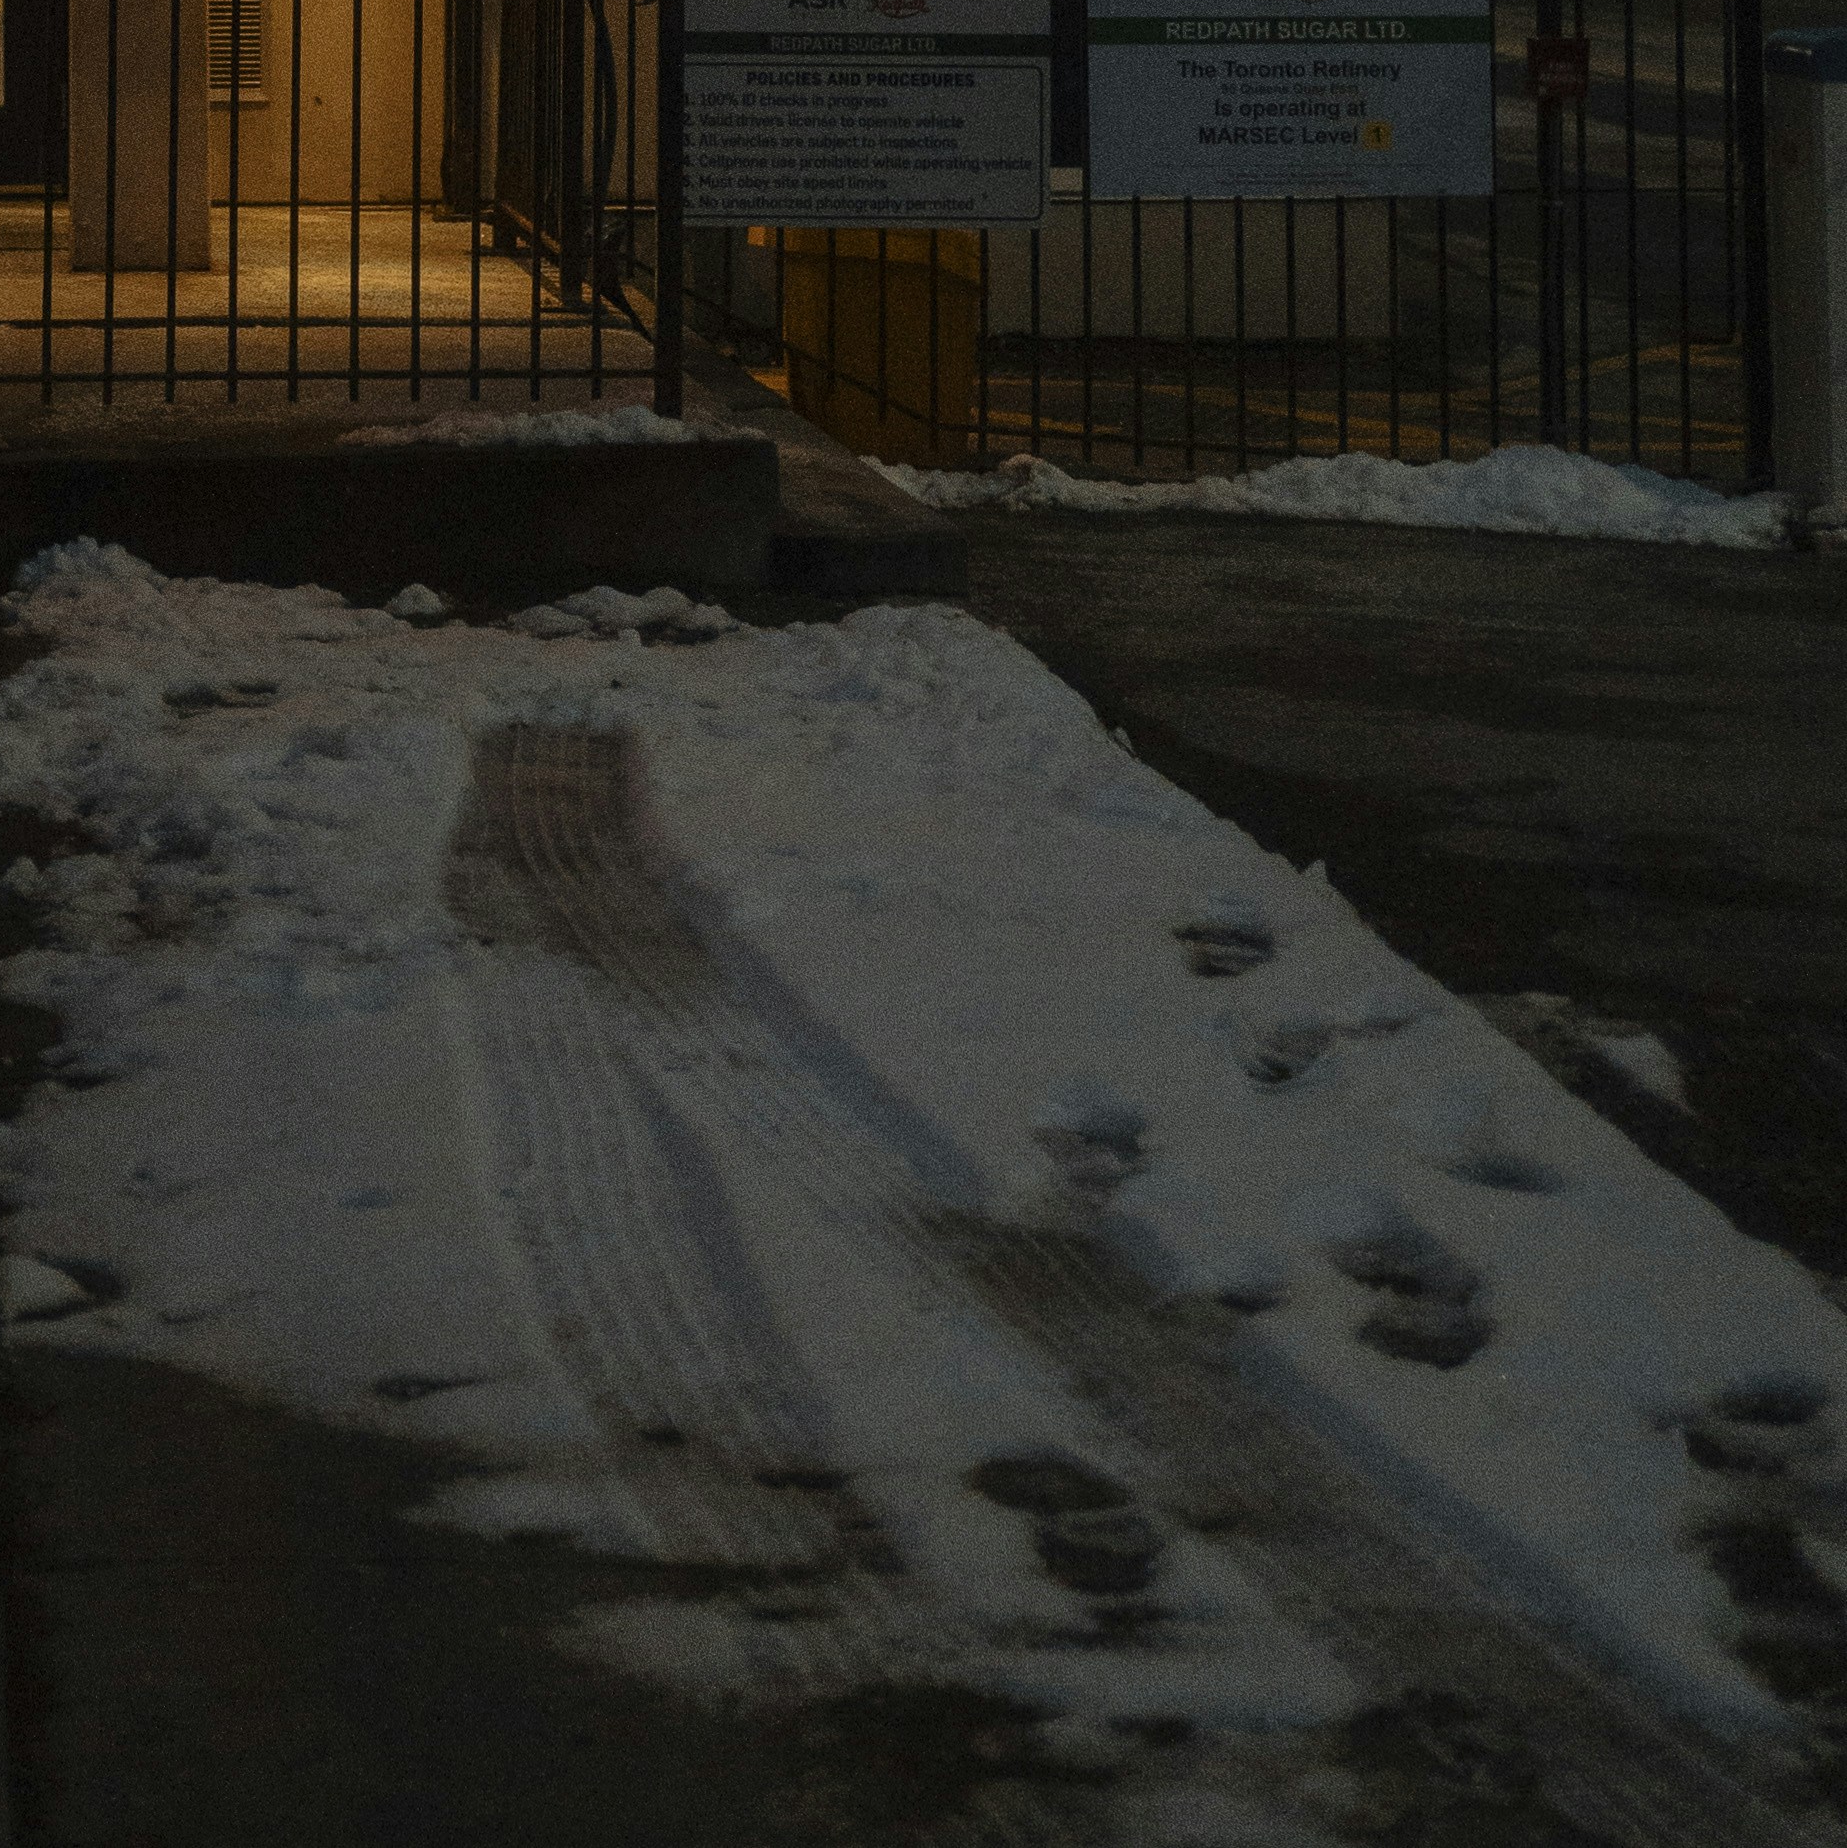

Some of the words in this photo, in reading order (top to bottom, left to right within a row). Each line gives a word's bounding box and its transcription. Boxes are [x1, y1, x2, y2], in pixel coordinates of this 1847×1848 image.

[1165, 21, 1270, 40] REDPATH
[1276, 21, 1358, 40] SUGAR
[1364, 21, 1412, 40] LTD.
[770, 35, 843, 52] REDPATH
[848, 36, 902, 52] SUGAR
[907, 36, 941, 53] LTD.
[746, 71, 822, 86] POLICIES
[827, 72, 861, 86] AND
[867, 73, 975, 87] PROCEDURES
[1177, 60, 1216, 79] The
[1224, 60, 1306, 79] Toronto
[1312, 60, 1401, 81] Refinery
[700, 93, 738, 106] 100%
[742, 94, 756, 106] ID
[759, 94, 807, 106] checks
[812, 94, 824, 106] in
[828, 96, 888, 110] progress
[1214, 99, 1232, 116] Is
[1239, 99, 1340, 121] operating
[1346, 100, 1367, 117] at
[699, 113, 732, 126] Valid
[736, 113, 784, 127] drivers
[788, 113, 837, 127] license
[840, 115, 855, 127] to
[858, 116, 911, 131] operate
[915, 114, 964, 128] vehicle
[699, 134, 720, 147] All
[721, 134, 777, 147] vehicles
[780, 137, 804, 147] are
[808, 135, 858, 150] subject
[861, 136, 875, 147] to
[879, 136, 958, 150] inspections
[1198, 127, 1295, 145] MARSEC
[1302, 126, 1358, 145] Level
[1372, 127, 1384, 143] 1
[699, 154, 768, 171] Cellphone
[771, 157, 796, 167] use
[799, 155, 869, 171] prohibited
[872, 156, 910, 169] while
[914, 156, 980, 172] operating
[984, 157, 1032, 170] vehicle
[699, 175, 733, 188] Must
[773, 175, 800, 188] site
[803, 176, 845, 192] speed
[848, 176, 887, 189] limits
[699, 196, 718, 208] No
[722, 196, 811, 209] unauthorized
[815, 197, 904, 213] photography
[905, 197, 974, 210] permitted
